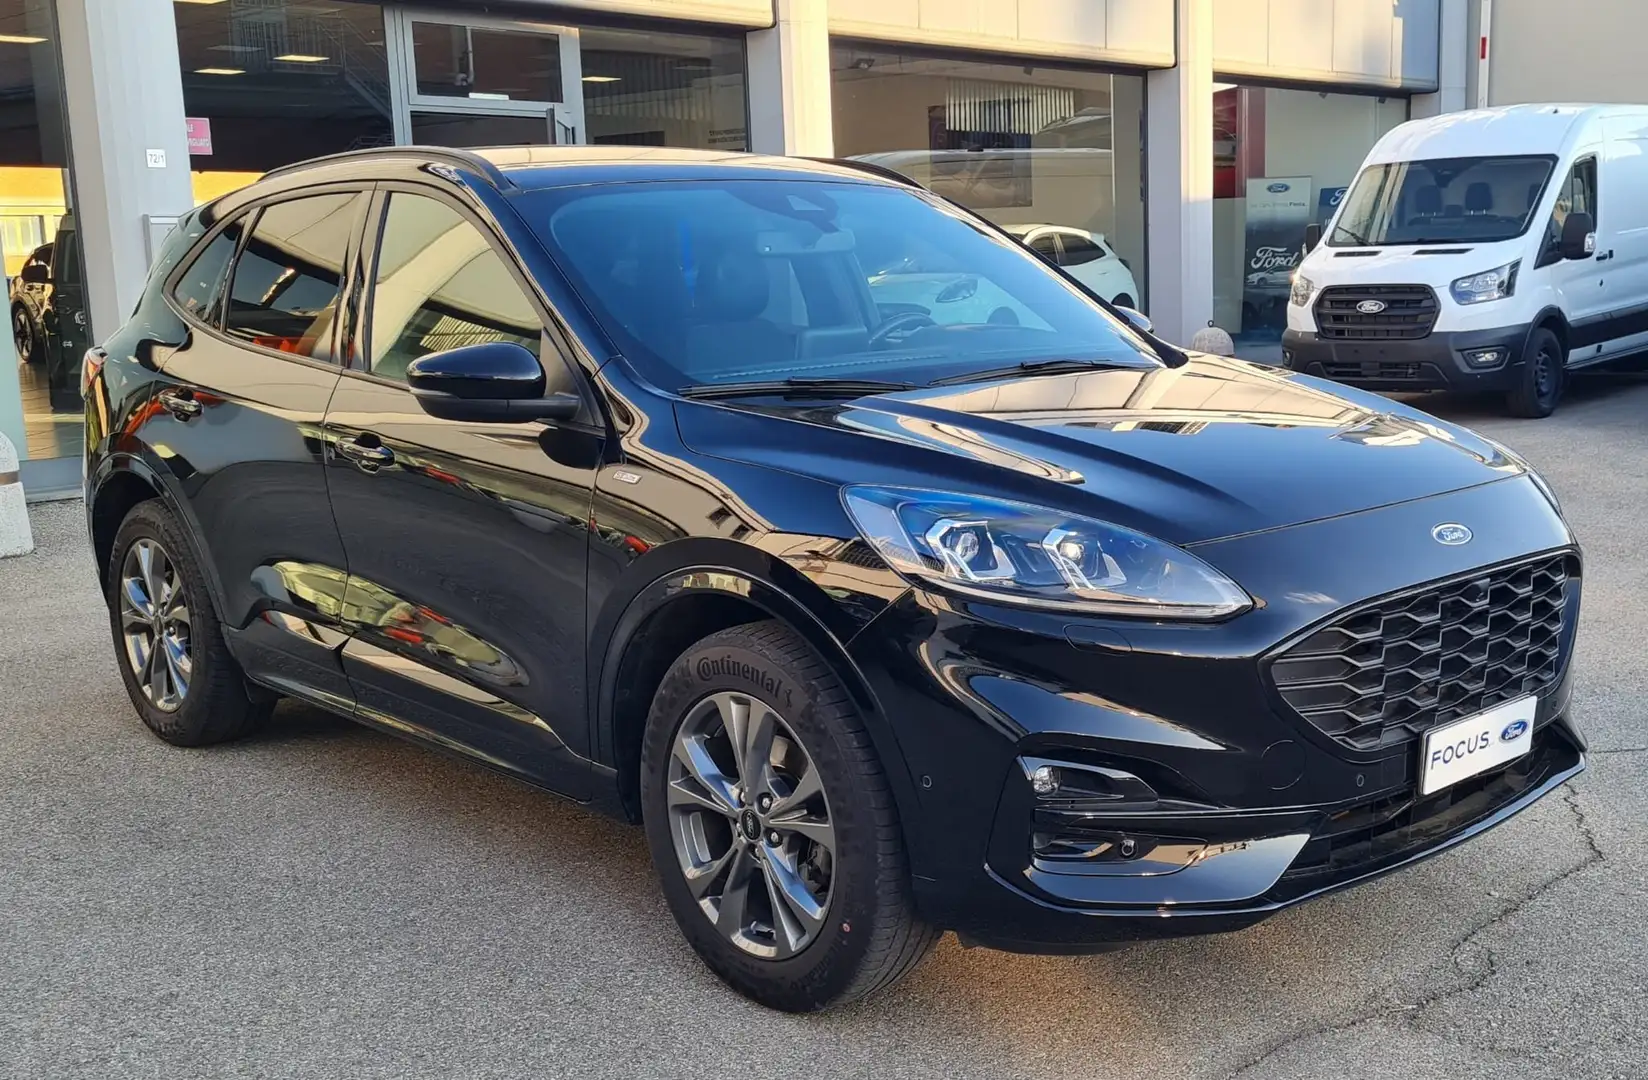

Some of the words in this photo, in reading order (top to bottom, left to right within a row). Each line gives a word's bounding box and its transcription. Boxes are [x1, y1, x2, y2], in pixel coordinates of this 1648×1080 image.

[148, 153, 165, 164] 72/1
[1250, 246, 1300, 269] Ford
[696, 654, 783, 698] Continental
[1430, 731, 1490, 770] FOCUS
